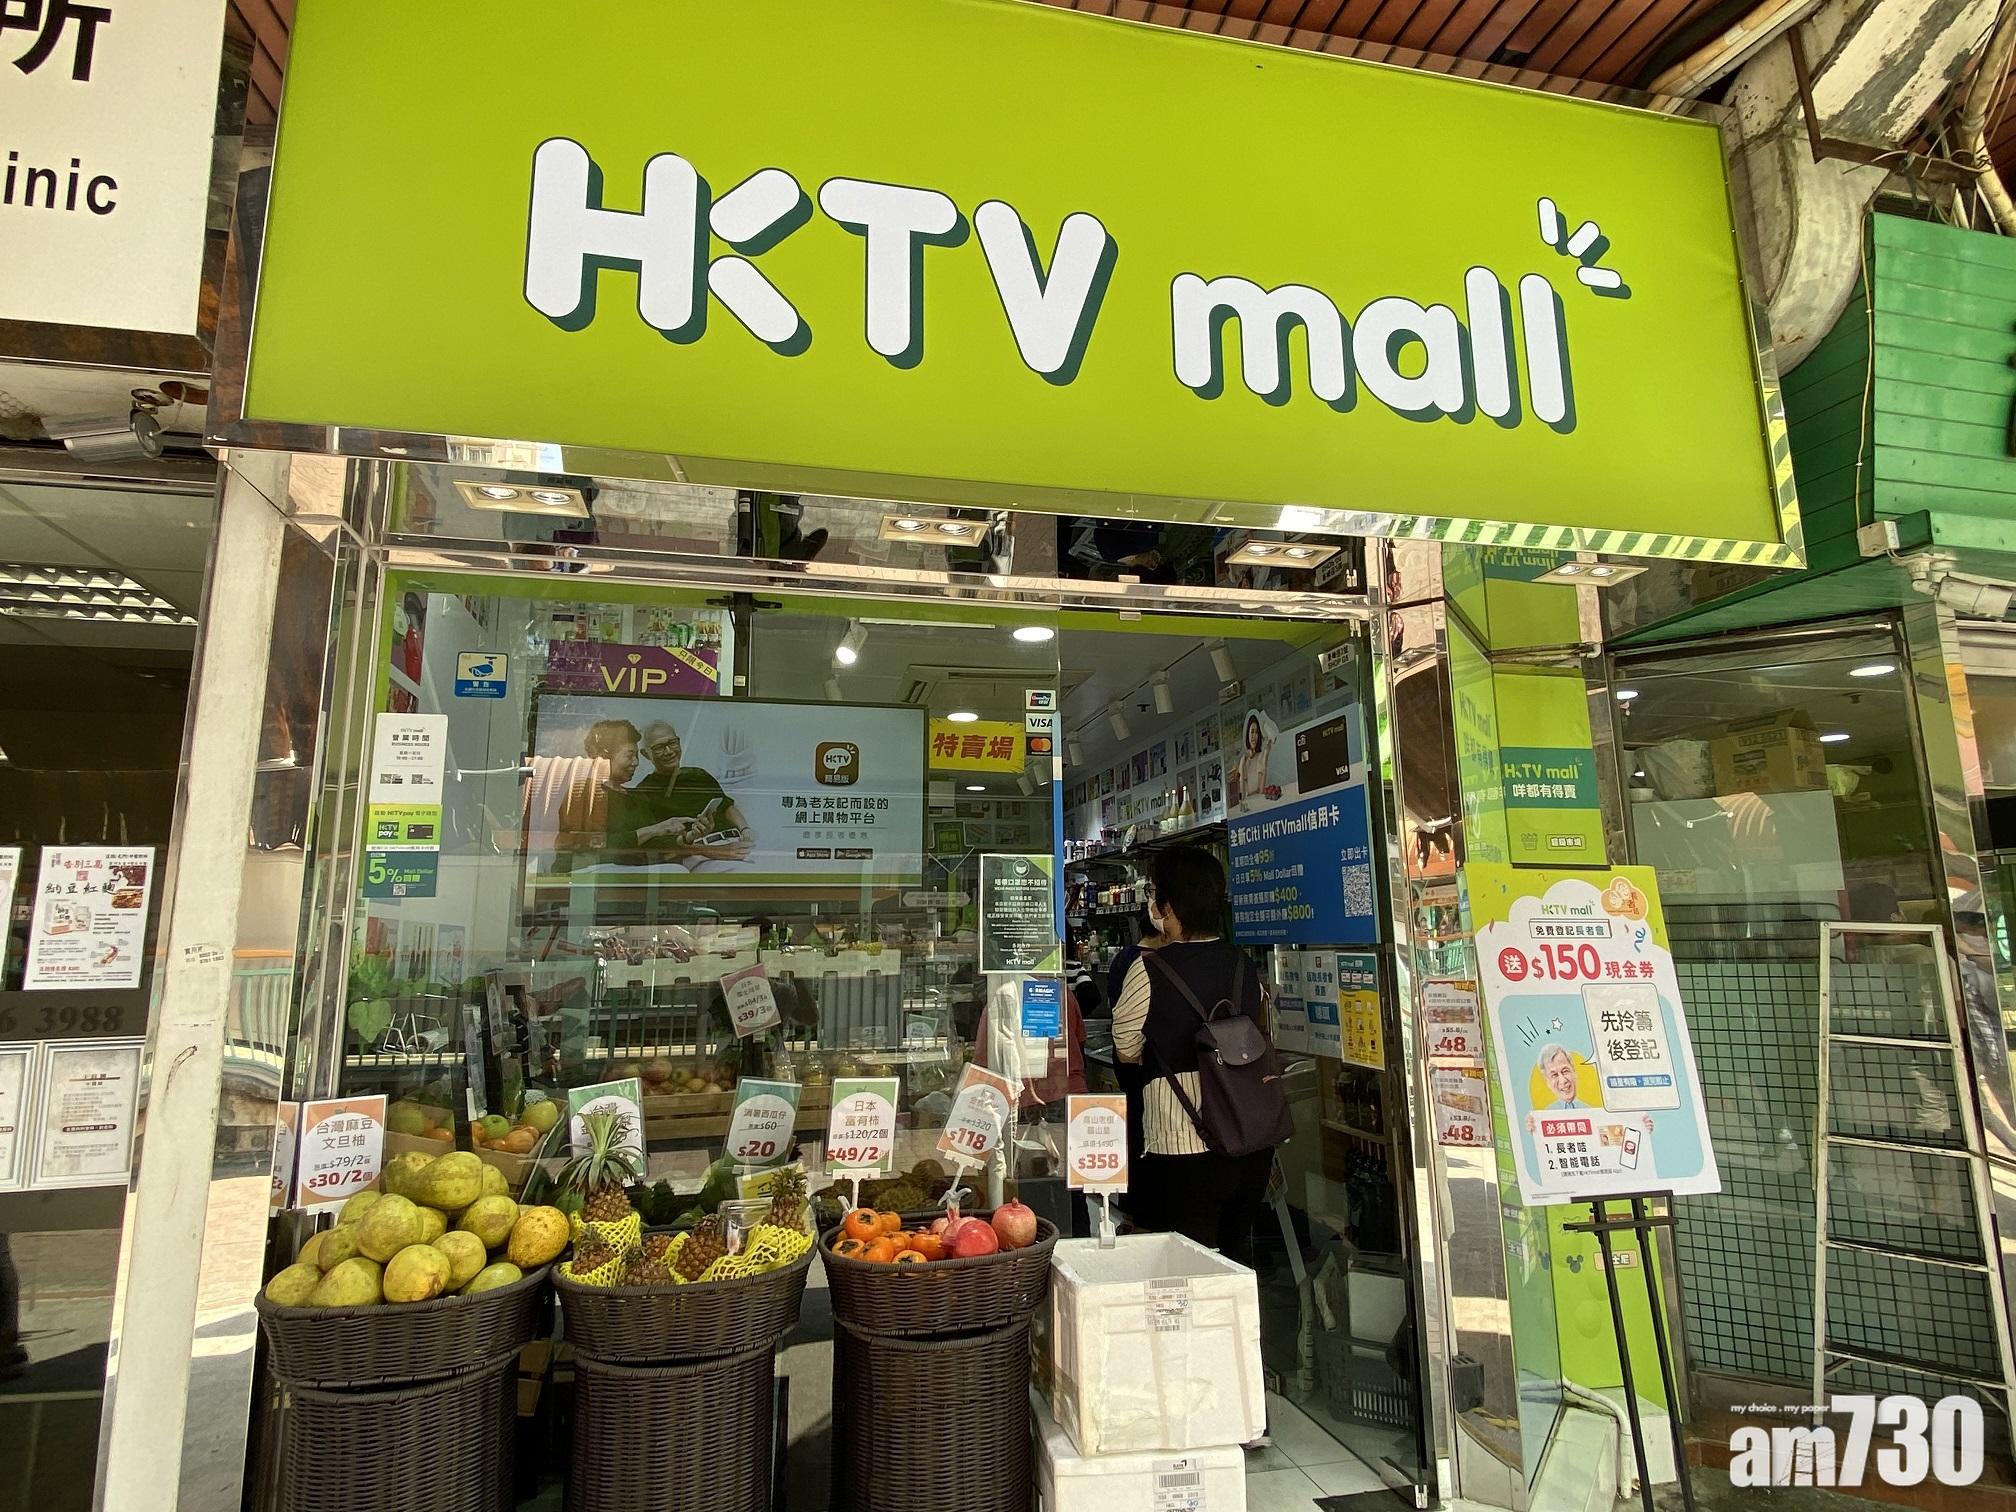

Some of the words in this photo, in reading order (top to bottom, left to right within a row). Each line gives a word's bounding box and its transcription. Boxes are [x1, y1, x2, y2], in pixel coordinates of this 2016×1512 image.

[523, 137, 1118, 387] HKTV
[1171, 265, 1577, 435] mall
[679, 649, 713, 676] 只限今日
[601, 666, 667, 693] VIP
[1030, 718, 1052, 728] VISA
[933, 732, 1014, 760] 特賣場
[825, 755, 850, 764] HKTV
[1335, 765, 1349, 776] VISA
[1546, 764, 1579, 780] mall
[782, 796, 889, 810] 專為老友記而設的
[795, 811, 876, 825] 網上購物平台
[1263, 804, 1340, 840] HKTVmall信用卡
[369, 858, 403, 884] 5%
[1542, 904, 1567, 915] HKTV
[1570, 904, 1593, 915] mall
[1535, 925, 1605, 936] 免費登記長者會
[1504, 955, 1523, 974] 送
[1531, 944, 1601, 981] $150
[1605, 960, 1655, 979] 現金券
[1607, 1039, 1660, 1061] 後登記
[854, 1100, 877, 1112] 日本
[316, 1117, 374, 1136] 台灣麻豆
[322, 1134, 366, 1150] 文旦柚
[949, 1127, 987, 1151] $118
[737, 1140, 776, 1157] $20
[1545, 1144, 1553, 1154] 1.
[1078, 1153, 1119, 1170] $358
[1548, 1160, 1558, 1170] 2.
[1559, 1156, 1601, 1169] 智能電話
[309, 1170, 373, 1188] $30/2個
